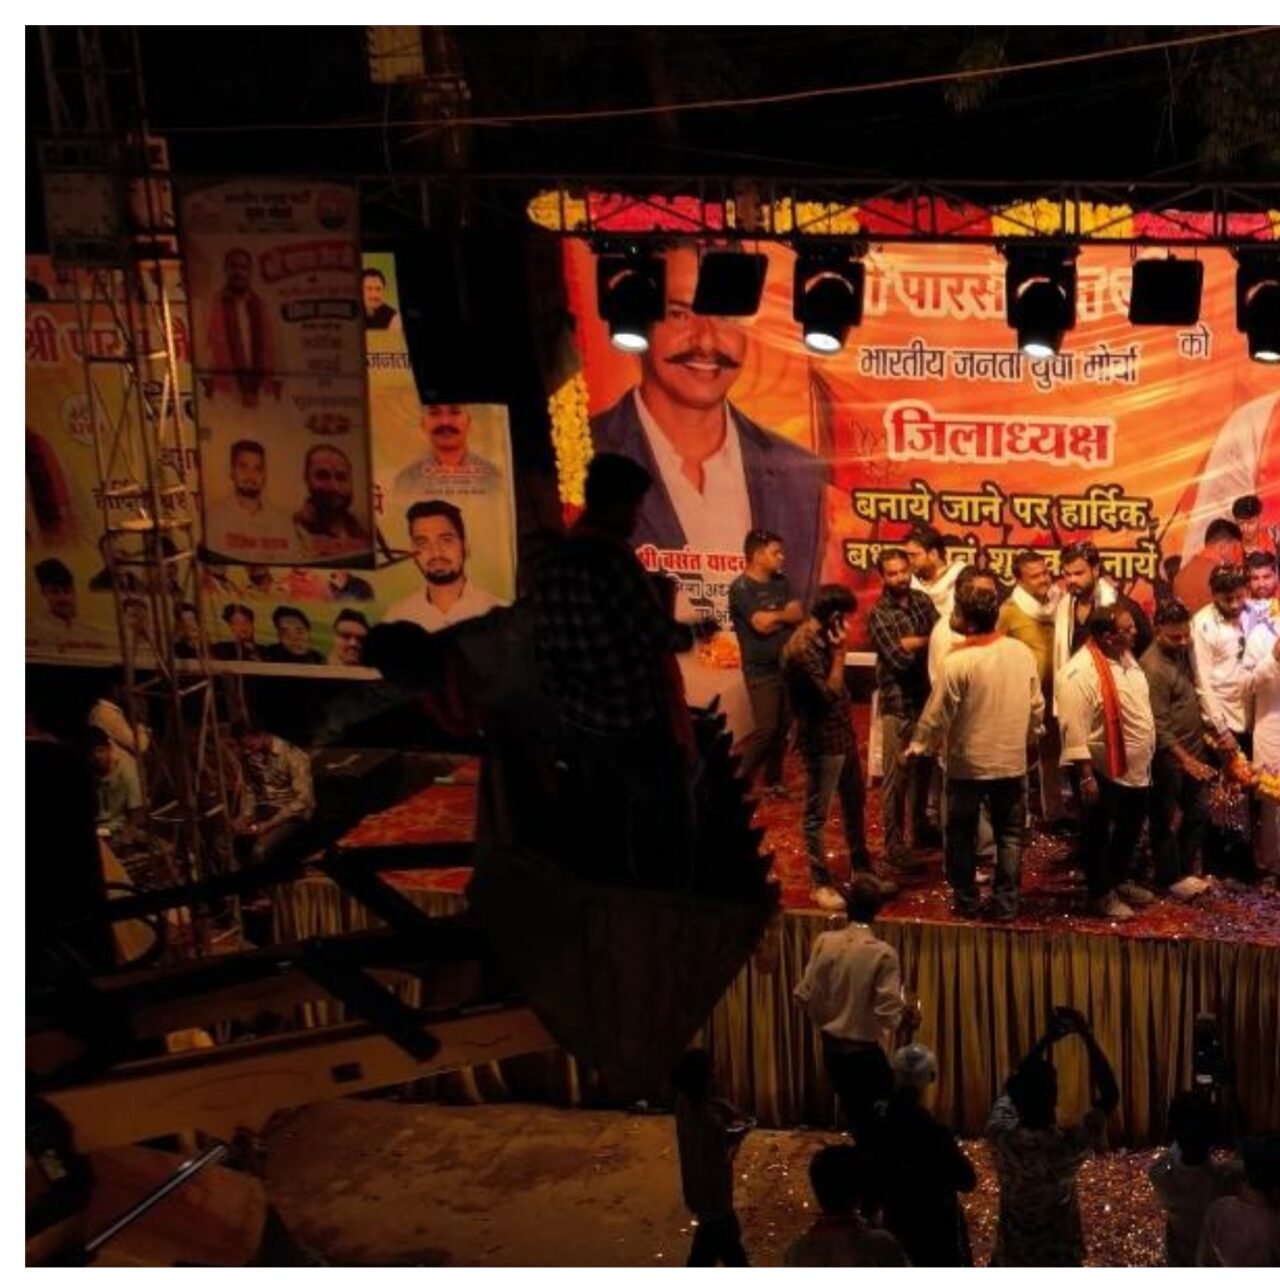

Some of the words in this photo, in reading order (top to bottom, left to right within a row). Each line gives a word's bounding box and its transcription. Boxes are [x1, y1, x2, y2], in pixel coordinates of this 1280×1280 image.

[861, 341, 944, 378] भारतीय
[953, 350, 1021, 379] जनता
[1031, 353, 1073, 387] युवा
[1084, 346, 1138, 383] मोर्चा
[1180, 329, 1209, 359] को
[890, 406, 1112, 462] जिलाध्यक्ष
[855, 484, 931, 521] बनाये
[942, 486, 1001, 523] जाने
[1014, 499, 1050, 525] पर
[1060, 488, 1148, 528] हार्दिक
